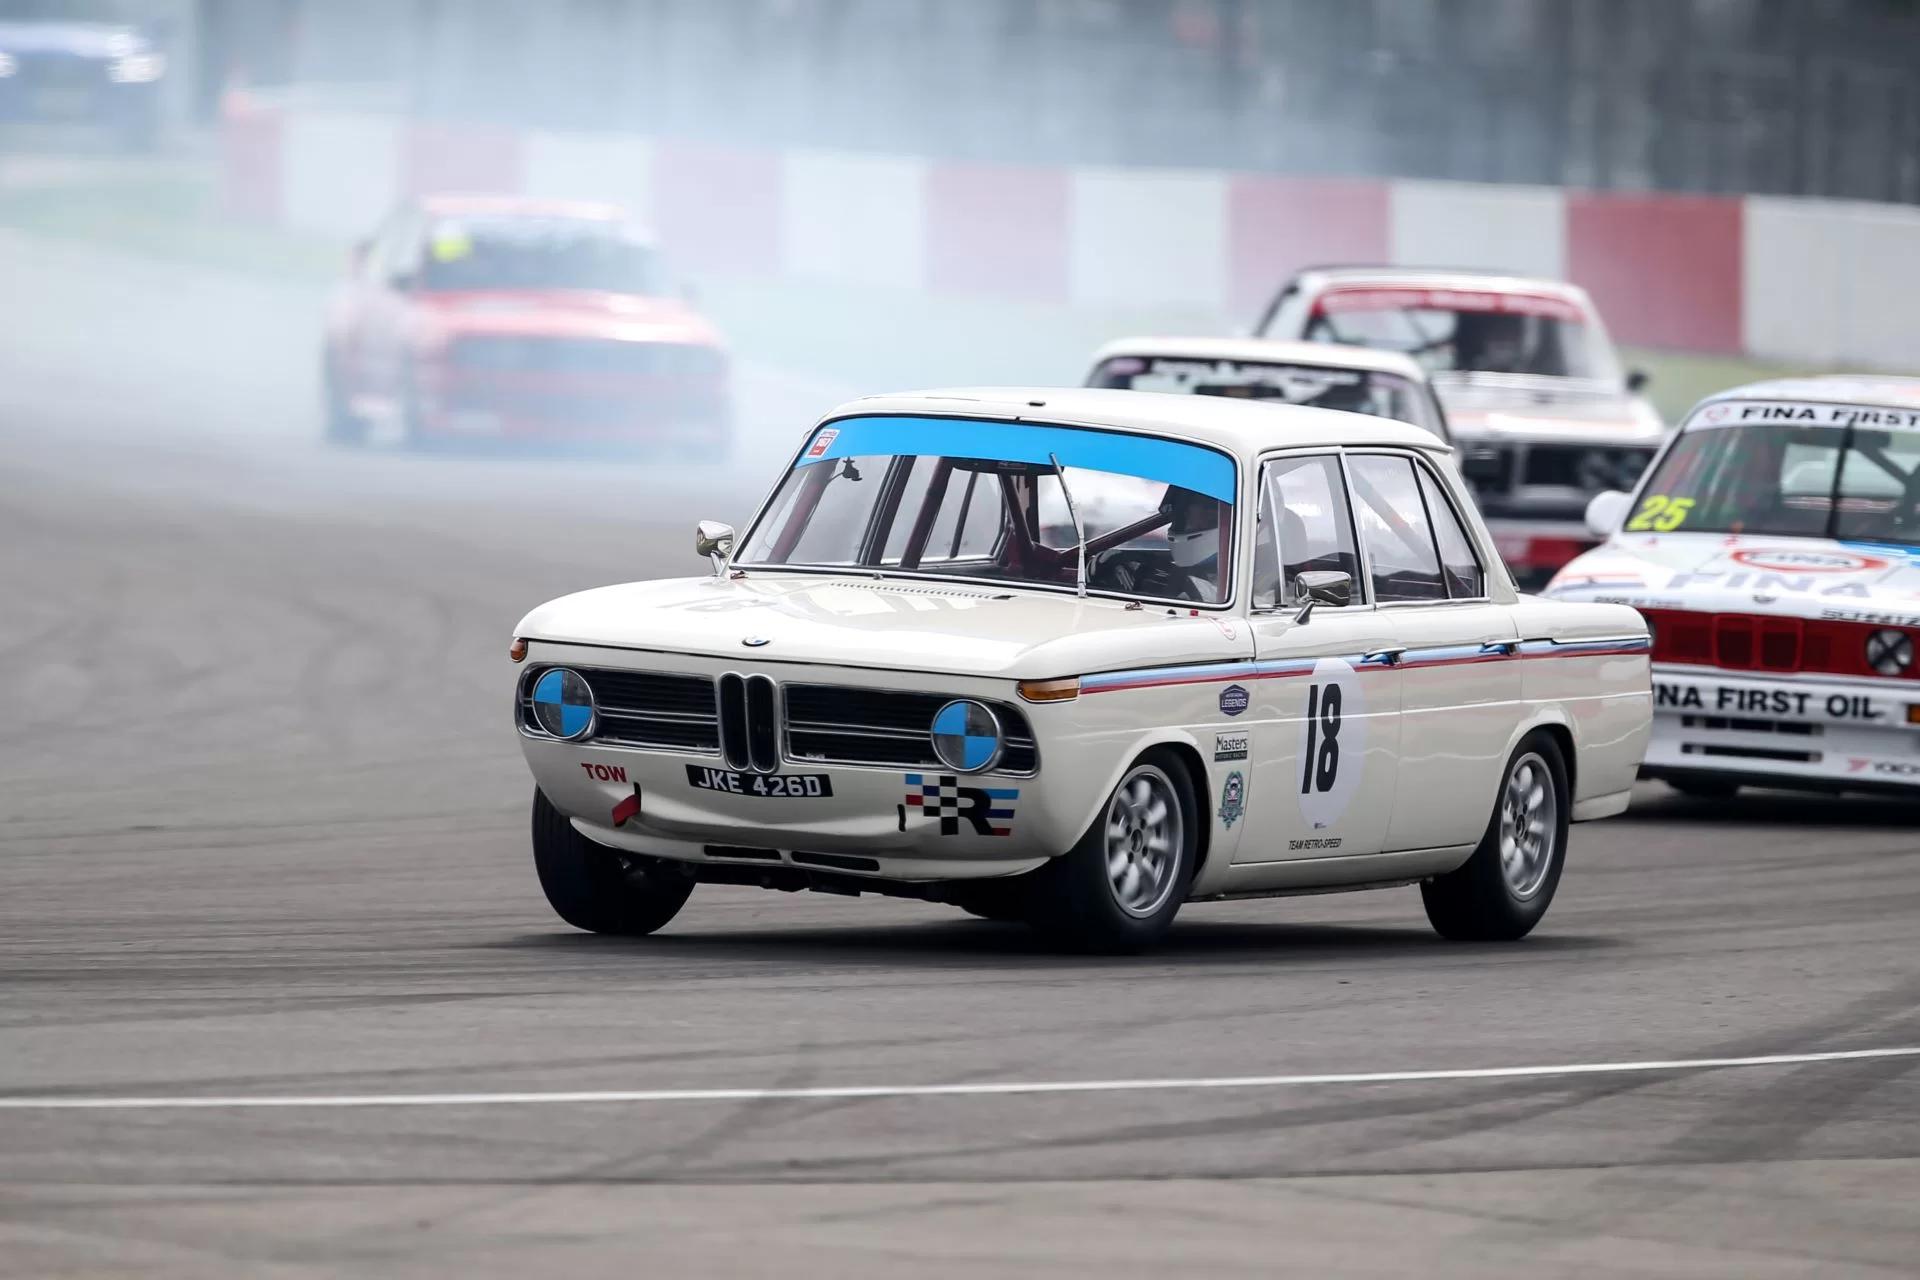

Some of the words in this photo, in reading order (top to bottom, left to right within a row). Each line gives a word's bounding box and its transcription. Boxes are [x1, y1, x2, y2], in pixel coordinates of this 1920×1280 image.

[1741, 407, 1816, 421] FINA
[1832, 408, 1920, 427] FIRST
[1626, 496, 1695, 531] 25
[1665, 571, 1871, 597] FINA
[1221, 698, 1248, 709] LEGENDS
[1717, 687, 1811, 714] FIRST
[1826, 694, 1884, 719] OIL
[1215, 735, 1248, 751] Masters
[1301, 683, 1342, 794] 18
[581, 762, 627, 783] TOW
[698, 769, 744, 793] JKE
[752, 775, 822, 796] 426D
[1288, 839, 1304, 850] TEAM
